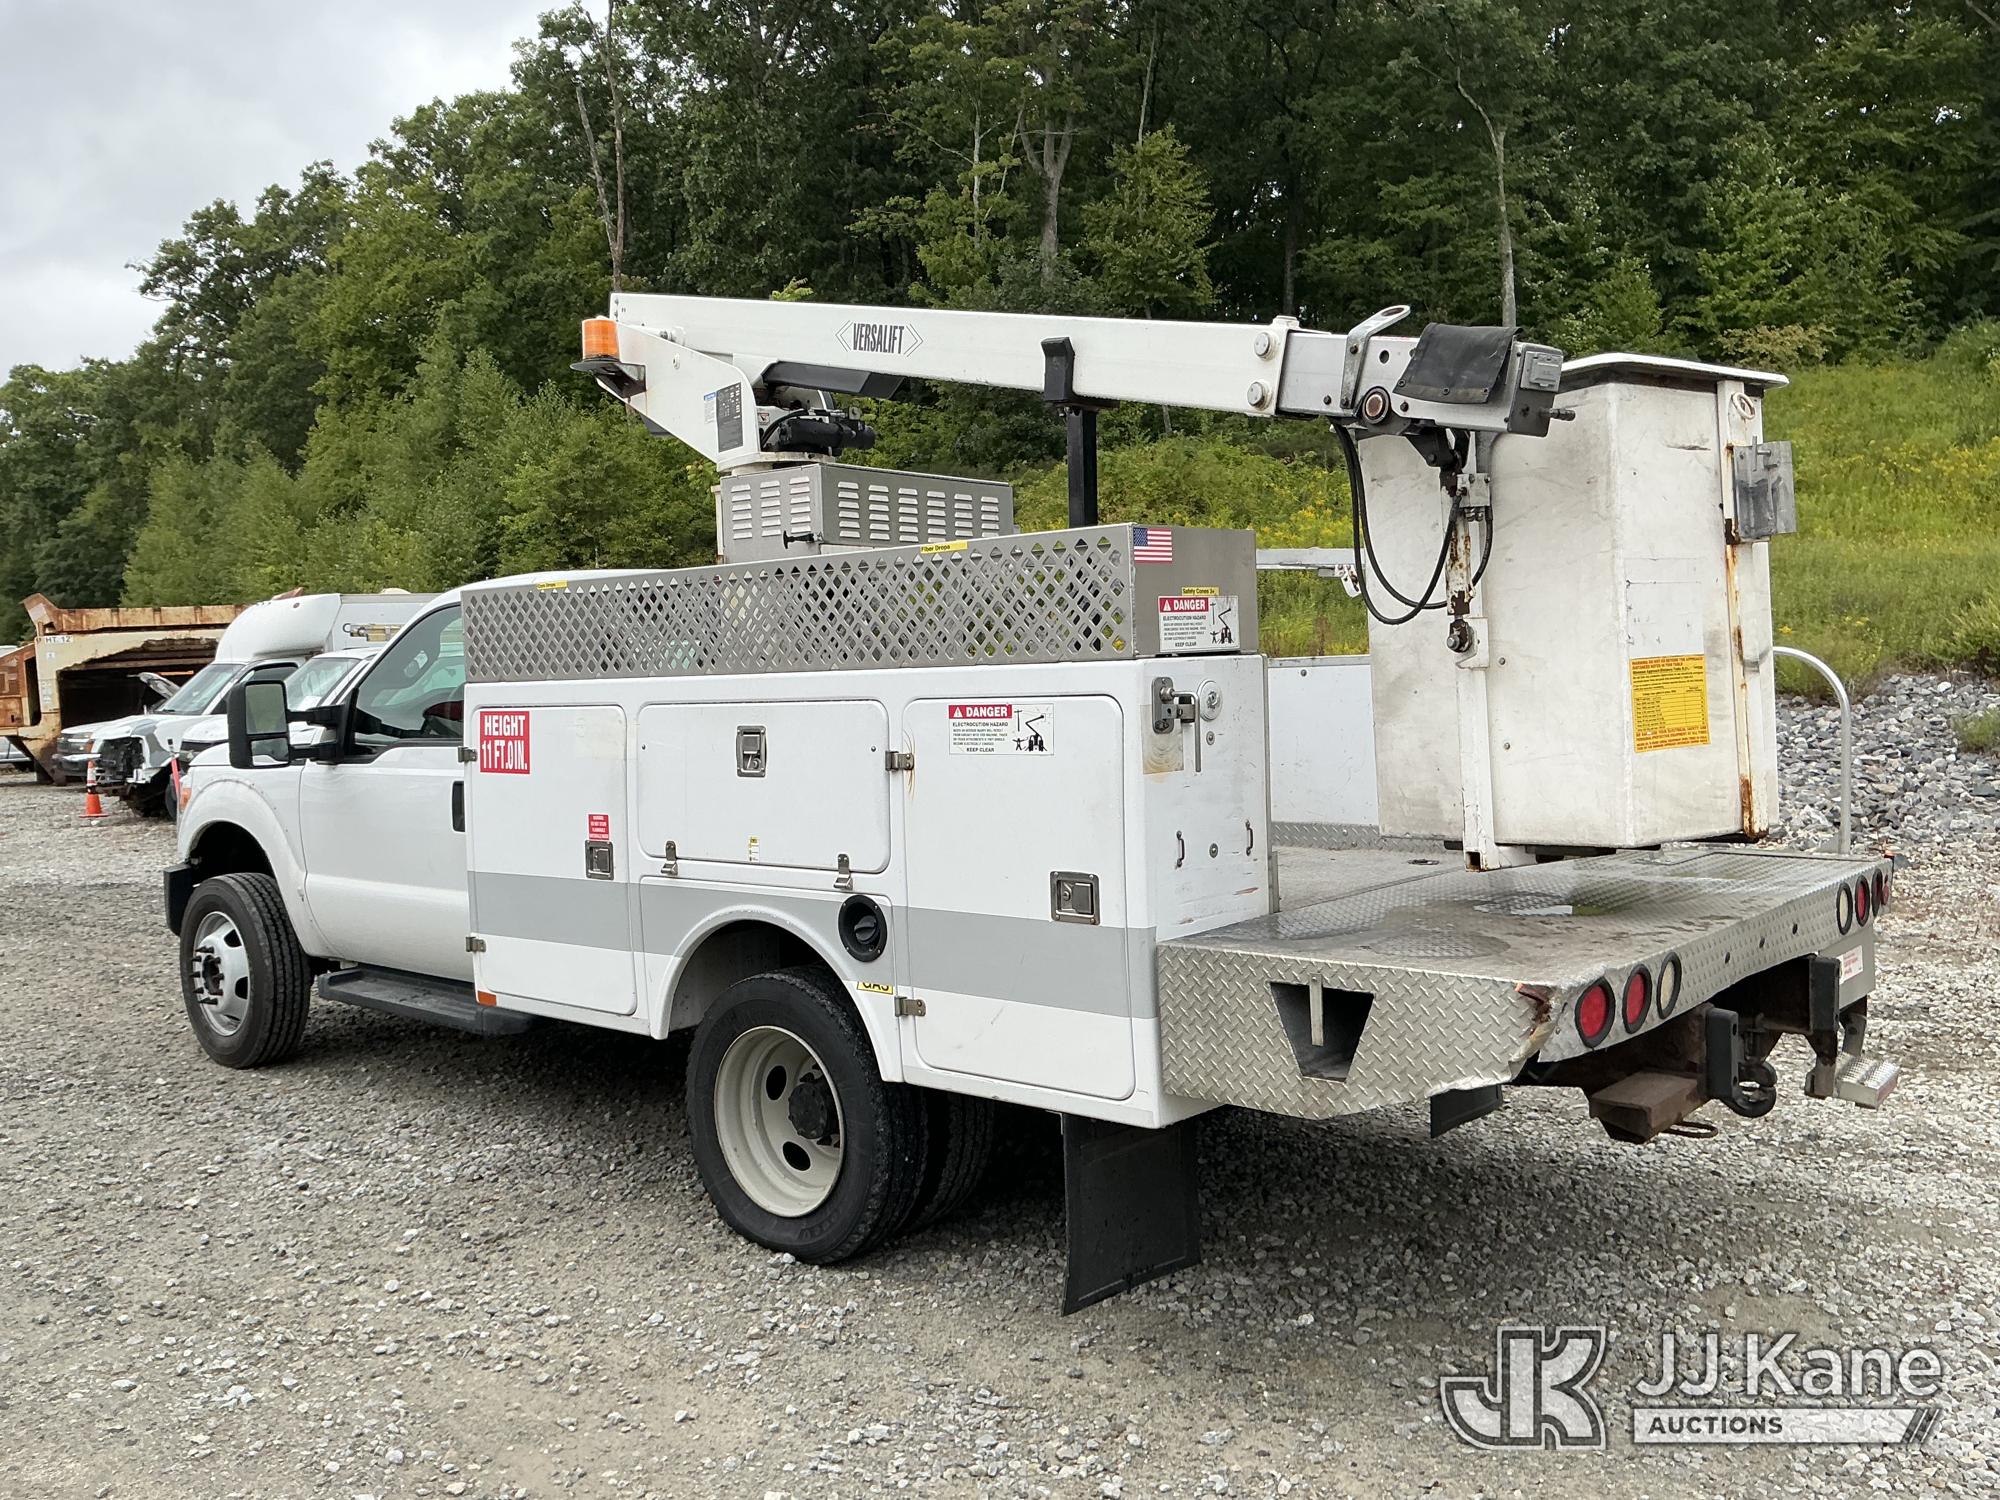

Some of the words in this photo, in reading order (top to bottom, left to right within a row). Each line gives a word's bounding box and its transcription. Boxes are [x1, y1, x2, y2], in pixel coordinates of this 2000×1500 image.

[852, 322, 905, 354] VERSALIFT
[1173, 599, 1206, 610] DANGER
[966, 706, 1008, 717] DANGER
[484, 714, 526, 737] HEIGHT
[481, 739, 492, 769] 11
